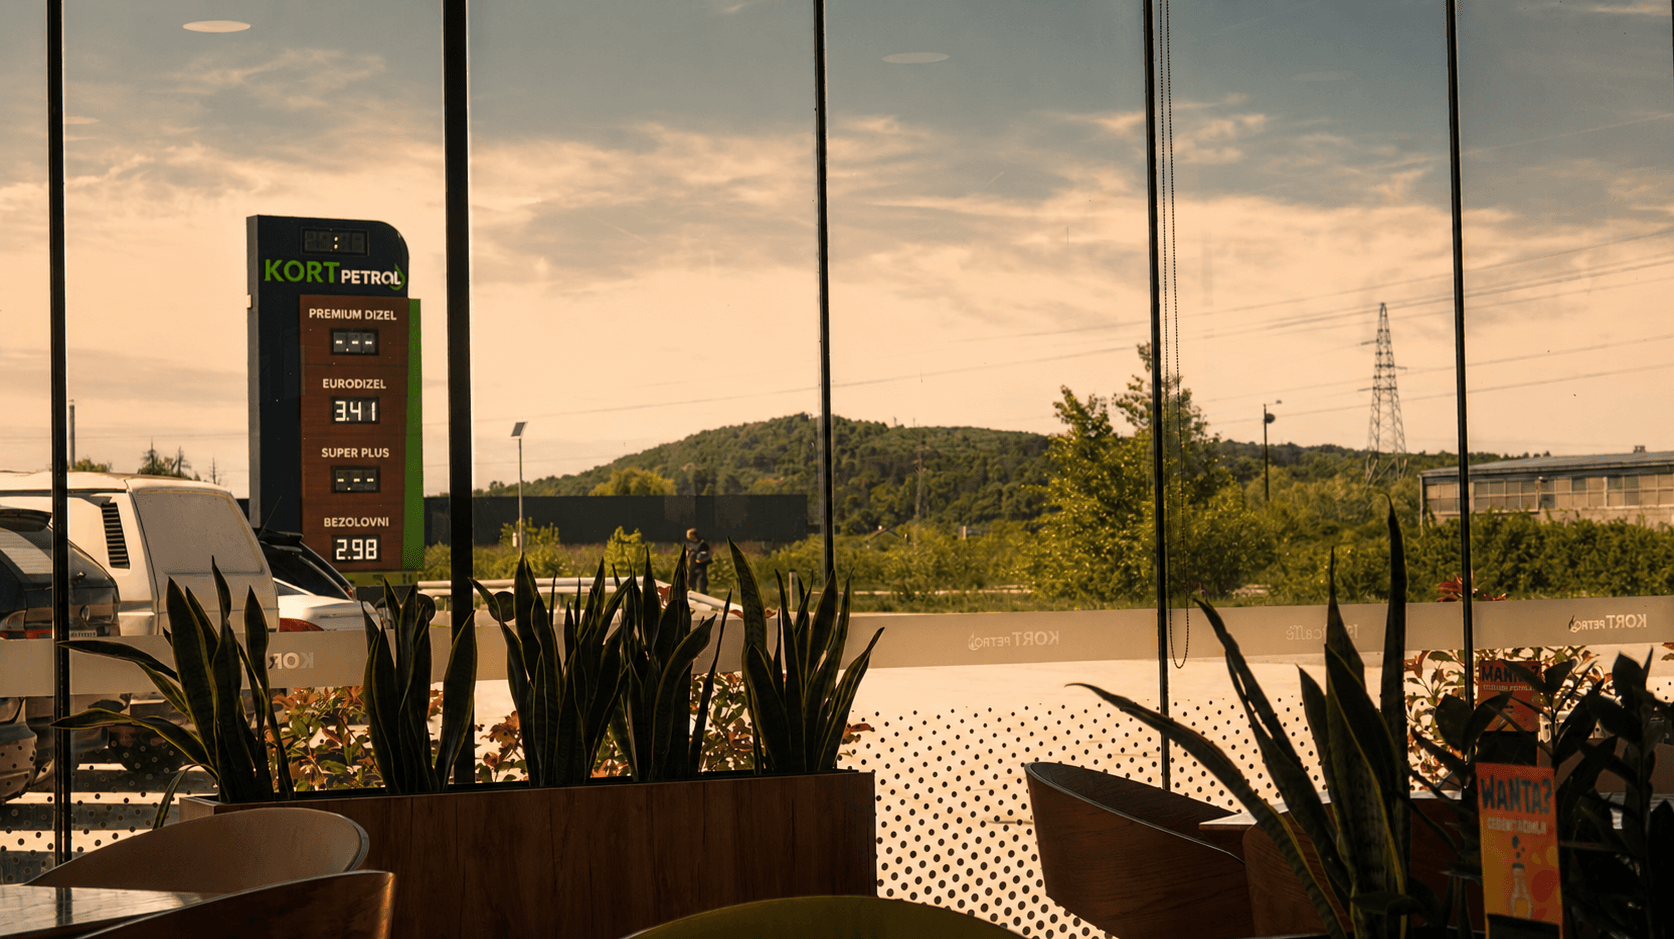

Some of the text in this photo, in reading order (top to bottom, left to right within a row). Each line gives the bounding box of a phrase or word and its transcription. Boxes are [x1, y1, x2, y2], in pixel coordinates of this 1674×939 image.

[264, 259, 402, 285] KORT PETROL
[308, 308, 397, 321] PREMIUM DIZEL
[322, 378, 387, 389] EURODIZEL
[335, 400, 376, 422] 3.41
[321, 448, 390, 458] SUPER PLUS
[323, 517, 389, 527] BEZOLOVNI
[336, 539, 377, 560] 2.98
[1480, 774, 1553, 815] WANTA?
